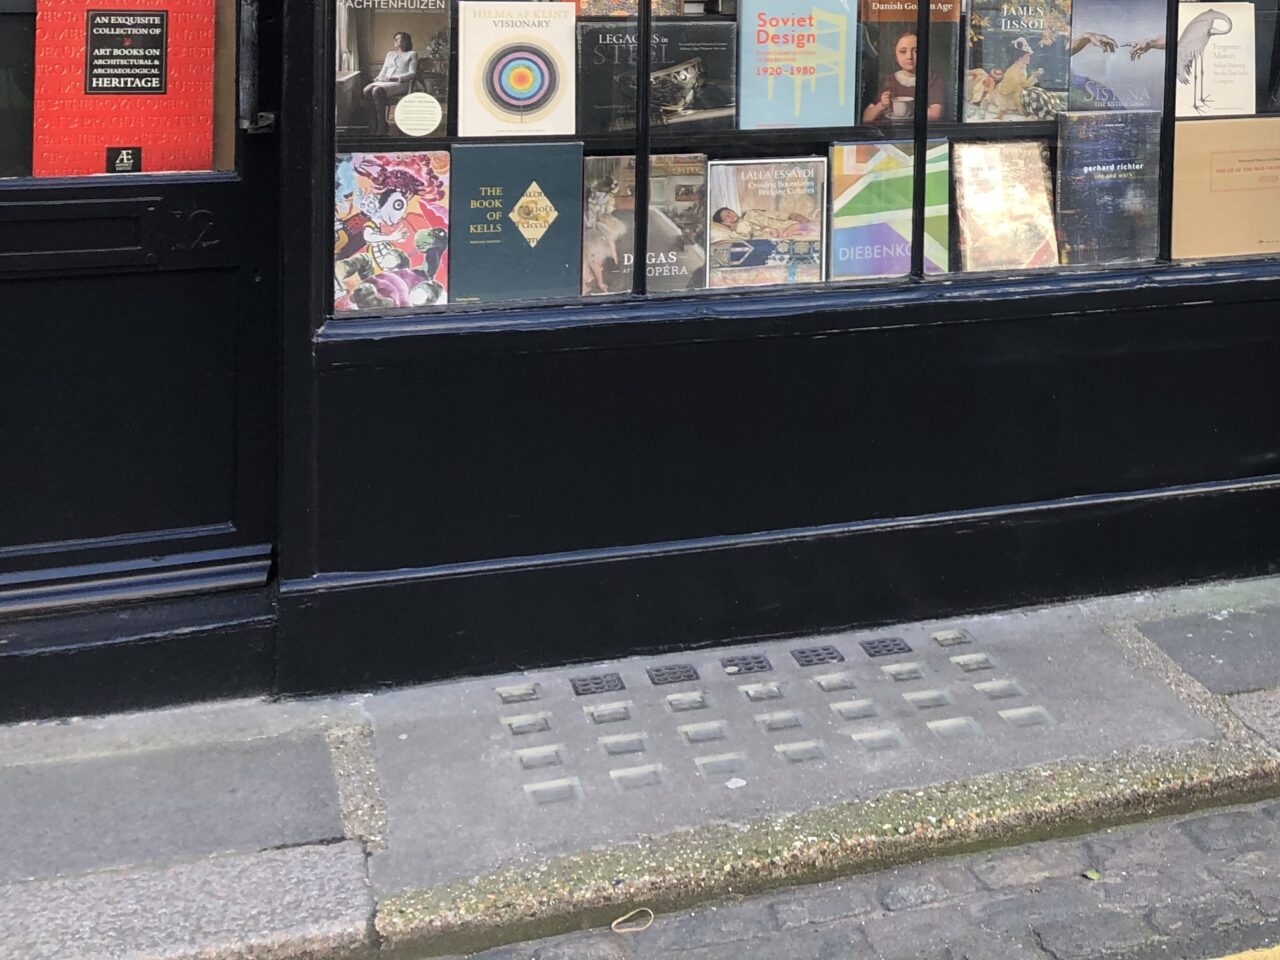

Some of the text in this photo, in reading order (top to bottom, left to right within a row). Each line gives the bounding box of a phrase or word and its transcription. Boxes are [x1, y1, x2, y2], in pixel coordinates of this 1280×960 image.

[872, 1, 953, 12] Danish Gon Age
[1001, 4, 1044, 17] JAMES
[94, 16, 161, 26] AN EXQUISITE
[493, 20, 550, 28] VISIONARY
[757, 12, 815, 28] Soviet
[1000, 18, 1045, 30] TISSOT
[93, 27, 162, 35] COLLECTION OF
[599, 33, 660, 44] LEGACS
[756, 29, 816, 49] Design
[93, 48, 160, 56] ART BOOKS ON
[92, 77, 160, 88] HERITAGE
[1117, 163, 1144, 171] richter
[741, 170, 772, 180] LALLA
[480, 187, 503, 196] THE
[470, 199, 503, 209] BOOK
[486, 211, 503, 220] OF
[469, 223, 502, 233] KELLS
[623, 251, 677, 265] DGAS
[646, 264, 688, 277] OPÉRA
